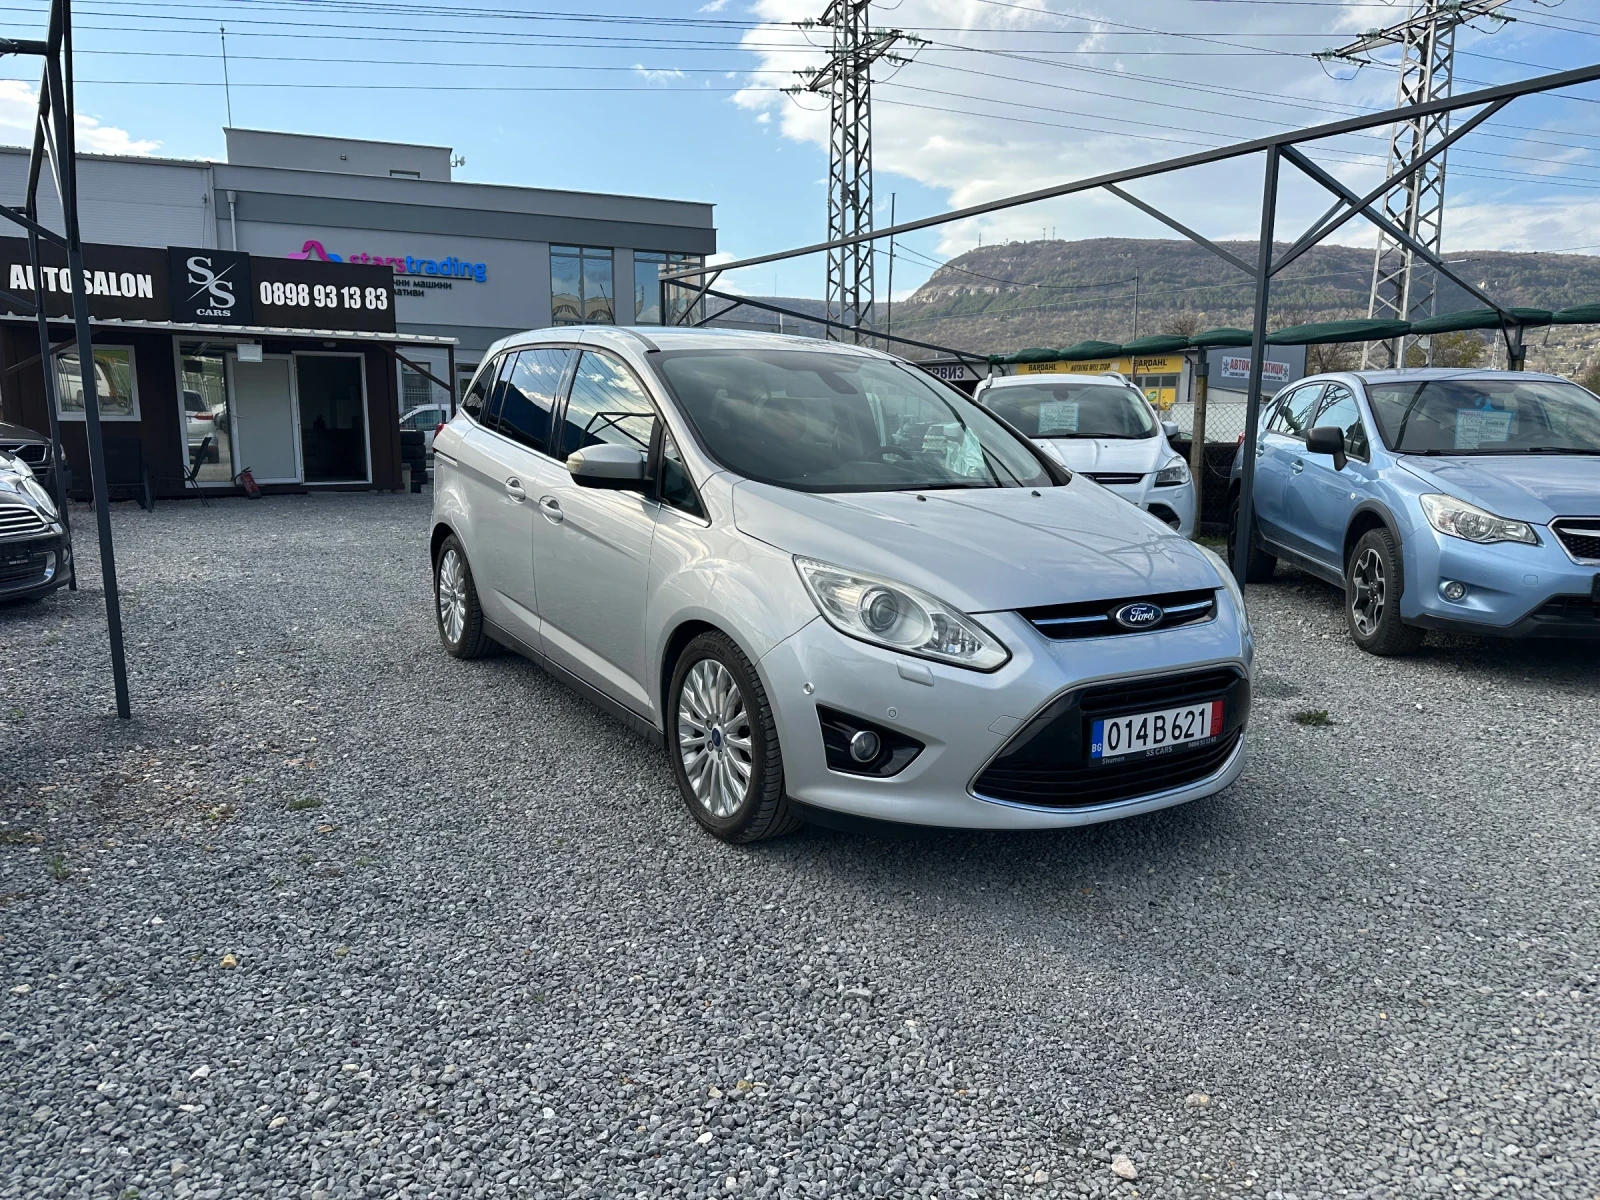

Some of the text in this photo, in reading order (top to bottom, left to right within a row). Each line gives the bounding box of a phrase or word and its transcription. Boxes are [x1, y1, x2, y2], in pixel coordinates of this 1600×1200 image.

[350, 252, 486, 282] starstrading
[413, 280, 452, 290] машини
[259, 281, 388, 310] 0898 93 13 83
[196, 308, 231, 317] CARS
[1028, 363, 1058, 374] BARDAHL
[1134, 358, 1168, 372] BARDAHL
[1130, 607, 1155, 622] Ford
[1092, 743, 1103, 753] BG
[1107, 708, 1206, 751] 014B621
[1145, 746, 1173, 757] SS CARS
